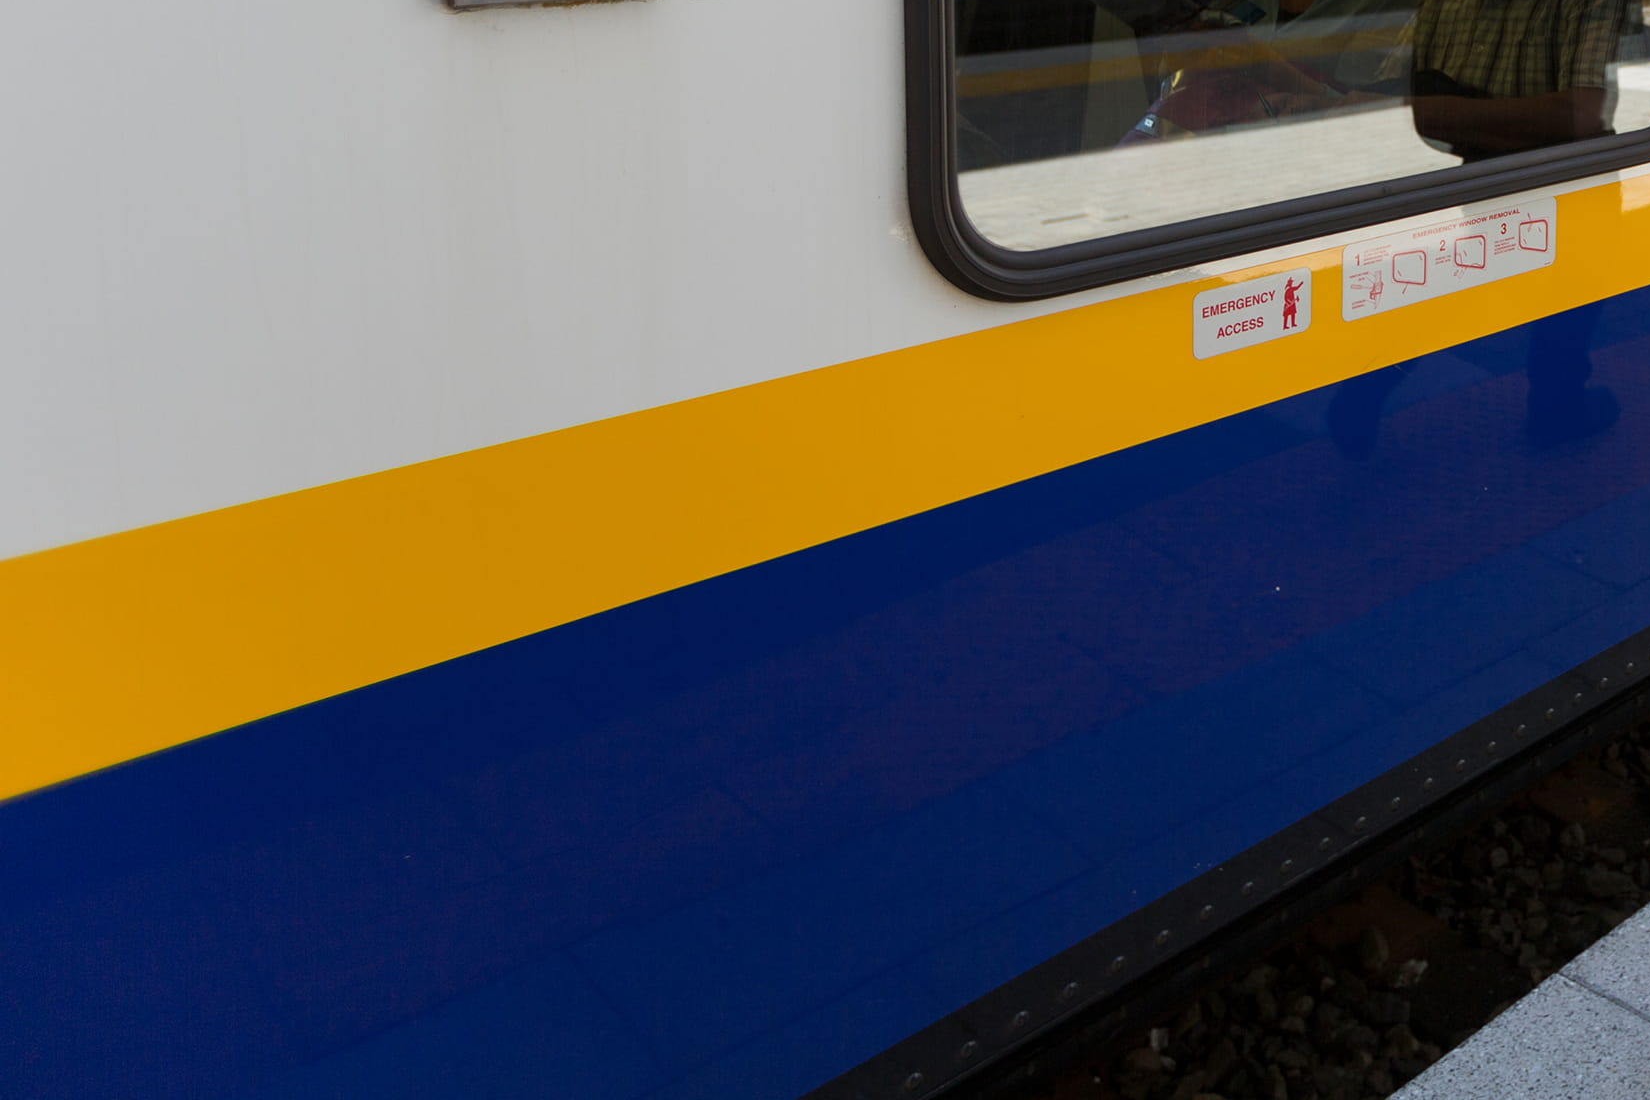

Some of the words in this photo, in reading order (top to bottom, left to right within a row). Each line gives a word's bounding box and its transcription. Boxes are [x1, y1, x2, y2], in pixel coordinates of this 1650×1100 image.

[1412, 224, 1458, 239] EMERGENCY
[1459, 217, 1488, 228] WINDOW
[1488, 209, 1521, 221] REMOVAL
[1500, 223, 1507, 235] 3
[1439, 240, 1446, 252] 2
[1354, 253, 1361, 266] 1
[1201, 289, 1276, 319] EMERGENCY
[1216, 316, 1264, 340] ACCESS
